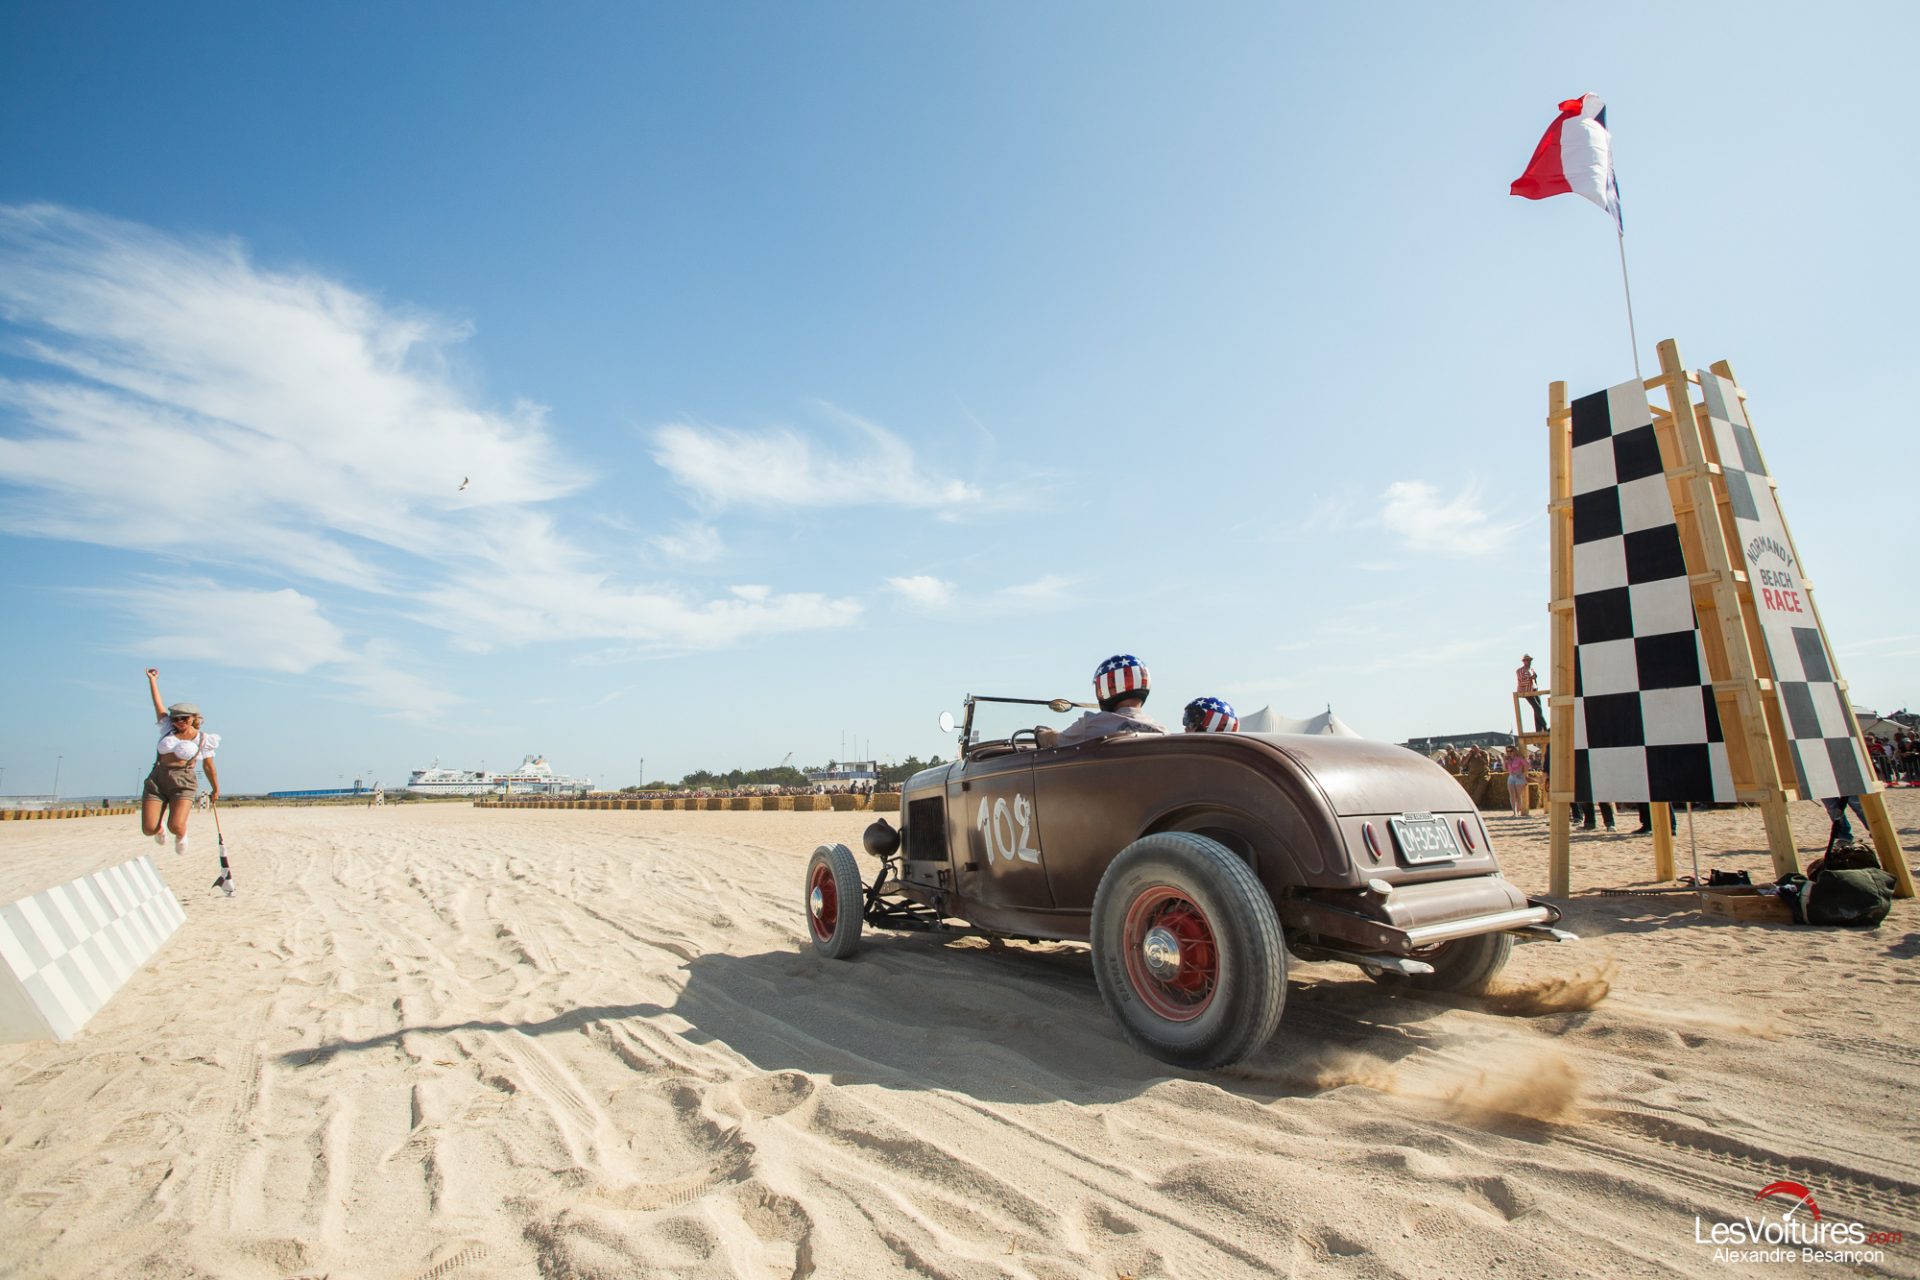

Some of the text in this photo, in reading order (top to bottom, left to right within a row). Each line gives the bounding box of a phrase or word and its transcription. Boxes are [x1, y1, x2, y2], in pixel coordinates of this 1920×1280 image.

[1746, 535, 1794, 568] NORMANDY
[1760, 568, 1793, 588] BEACH
[1762, 588, 1803, 613] RACE
[977, 793, 1040, 866] 102
